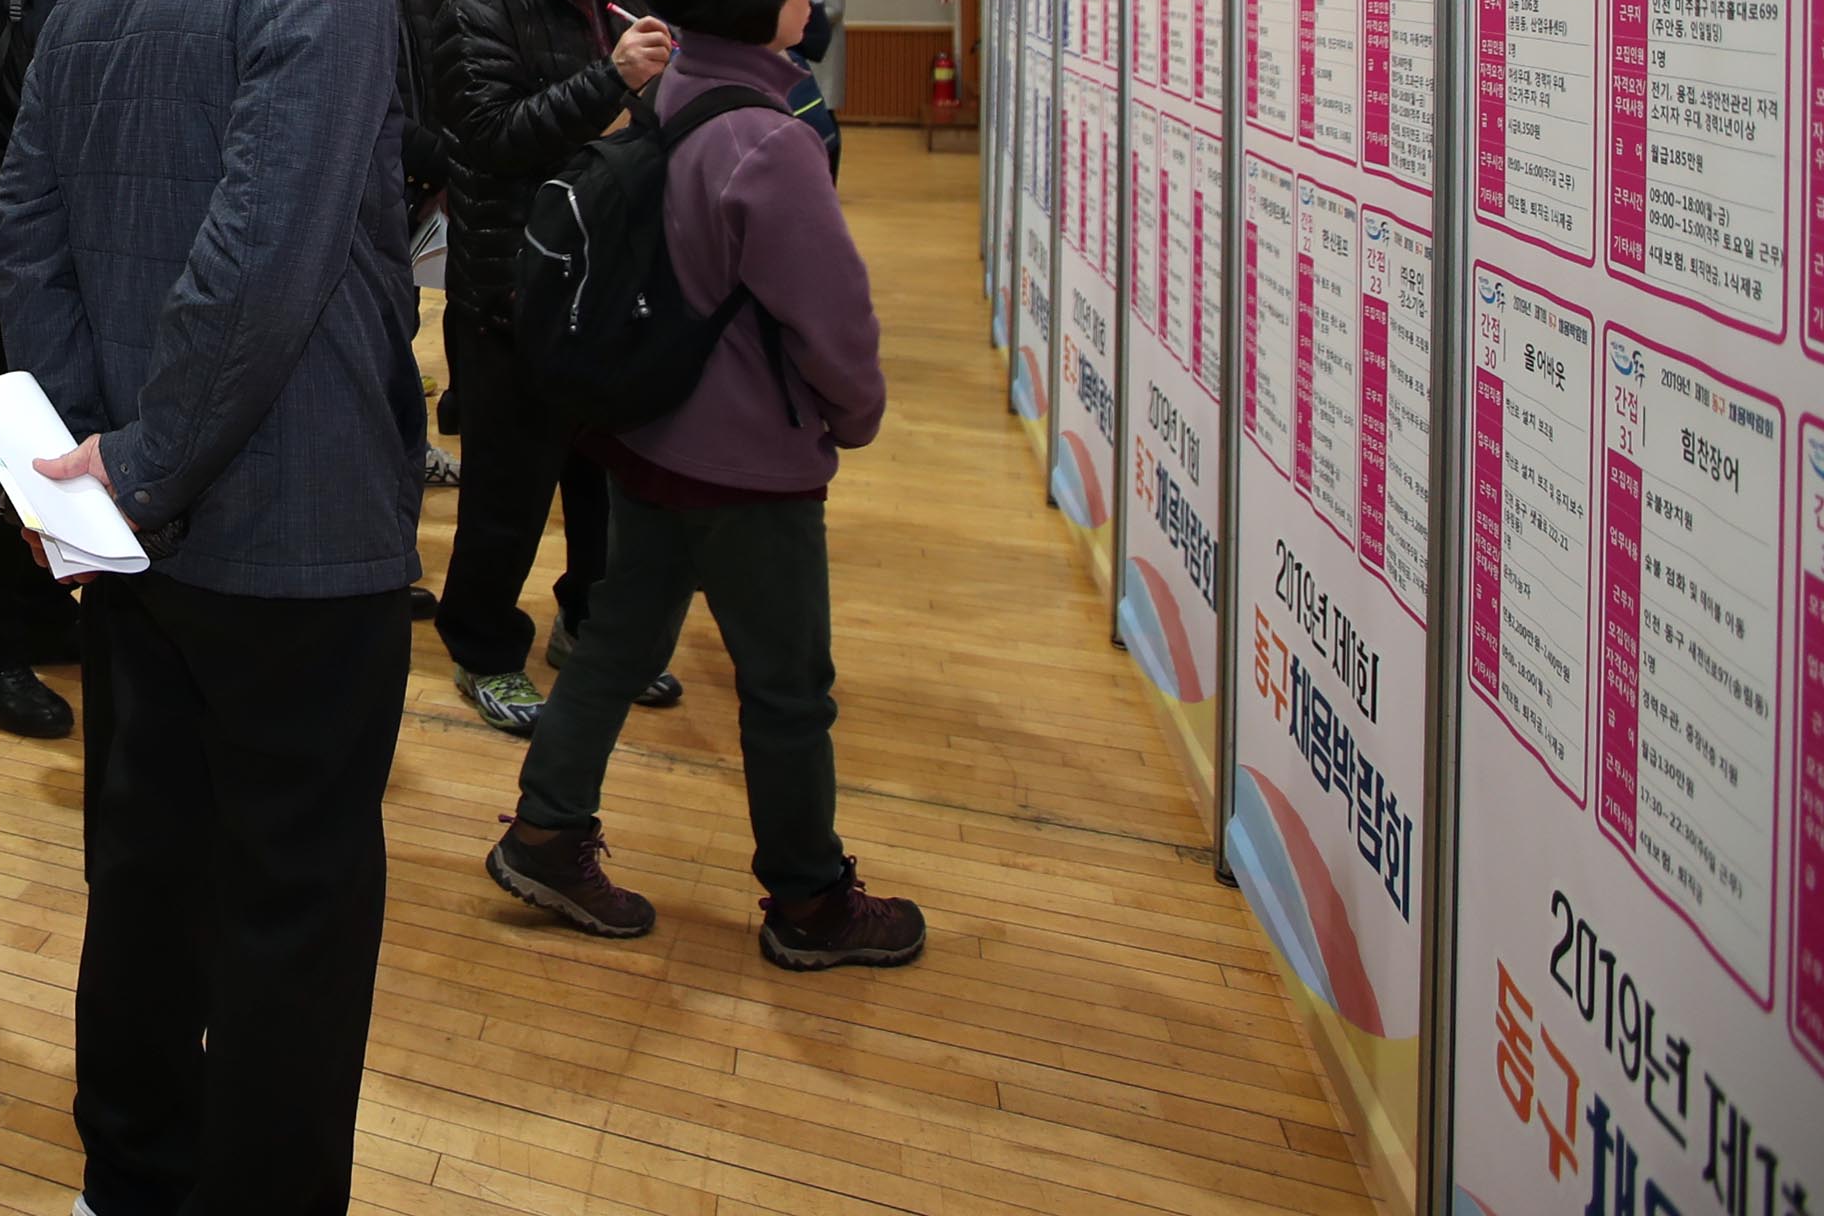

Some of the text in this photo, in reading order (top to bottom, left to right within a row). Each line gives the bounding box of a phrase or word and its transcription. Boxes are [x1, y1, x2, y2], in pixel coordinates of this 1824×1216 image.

[1620, 5, 1641, 23] 근무지
[1615, 46, 1644, 65] 모집인원
[1652, 50, 1665, 68] 1명
[1615, 96, 1643, 118] 우대사항
[1651, 106, 1680, 123] 소지자
[1757, 99, 1777, 120] 자격
[1651, 144, 1703, 173] 월급185만원
[1614, 187, 1643, 212] 근무시간
[1368, 248, 1385, 272] 간접
[1614, 235, 1642, 260] 기타사항
[1723, 234, 1754, 259] 토요일
[1371, 276, 1382, 294] 23
[1724, 272, 1762, 301] 1식제공
[1481, 313, 1500, 344] 간접
[1484, 346, 1496, 369] 30
[1524, 343, 1566, 392] 올어바웃
[1615, 385, 1637, 424] 간접
[1661, 368, 1690, 396] 2019년
[1712, 393, 1725, 416] 동구
[1729, 402, 1774, 439] 채용박람회
[1620, 426, 1633, 455] 31
[1681, 428, 1739, 493] 힘찬장어
[1611, 466, 1639, 499] 모집직종
[1156, 459, 1218, 612] 채용박람회
[1613, 584, 1633, 615] 근무지
[1276, 539, 1380, 724] 2019년 제1회
[1664, 624, 1685, 649] 동구
[1643, 651, 1656, 674] 1명
[1255, 603, 1413, 924] 동구 채용박람회
[1642, 739, 1695, 799] 월급130만원
[1551, 890, 1691, 1151] 2019년
[1496, 957, 1581, 1184] 동구
